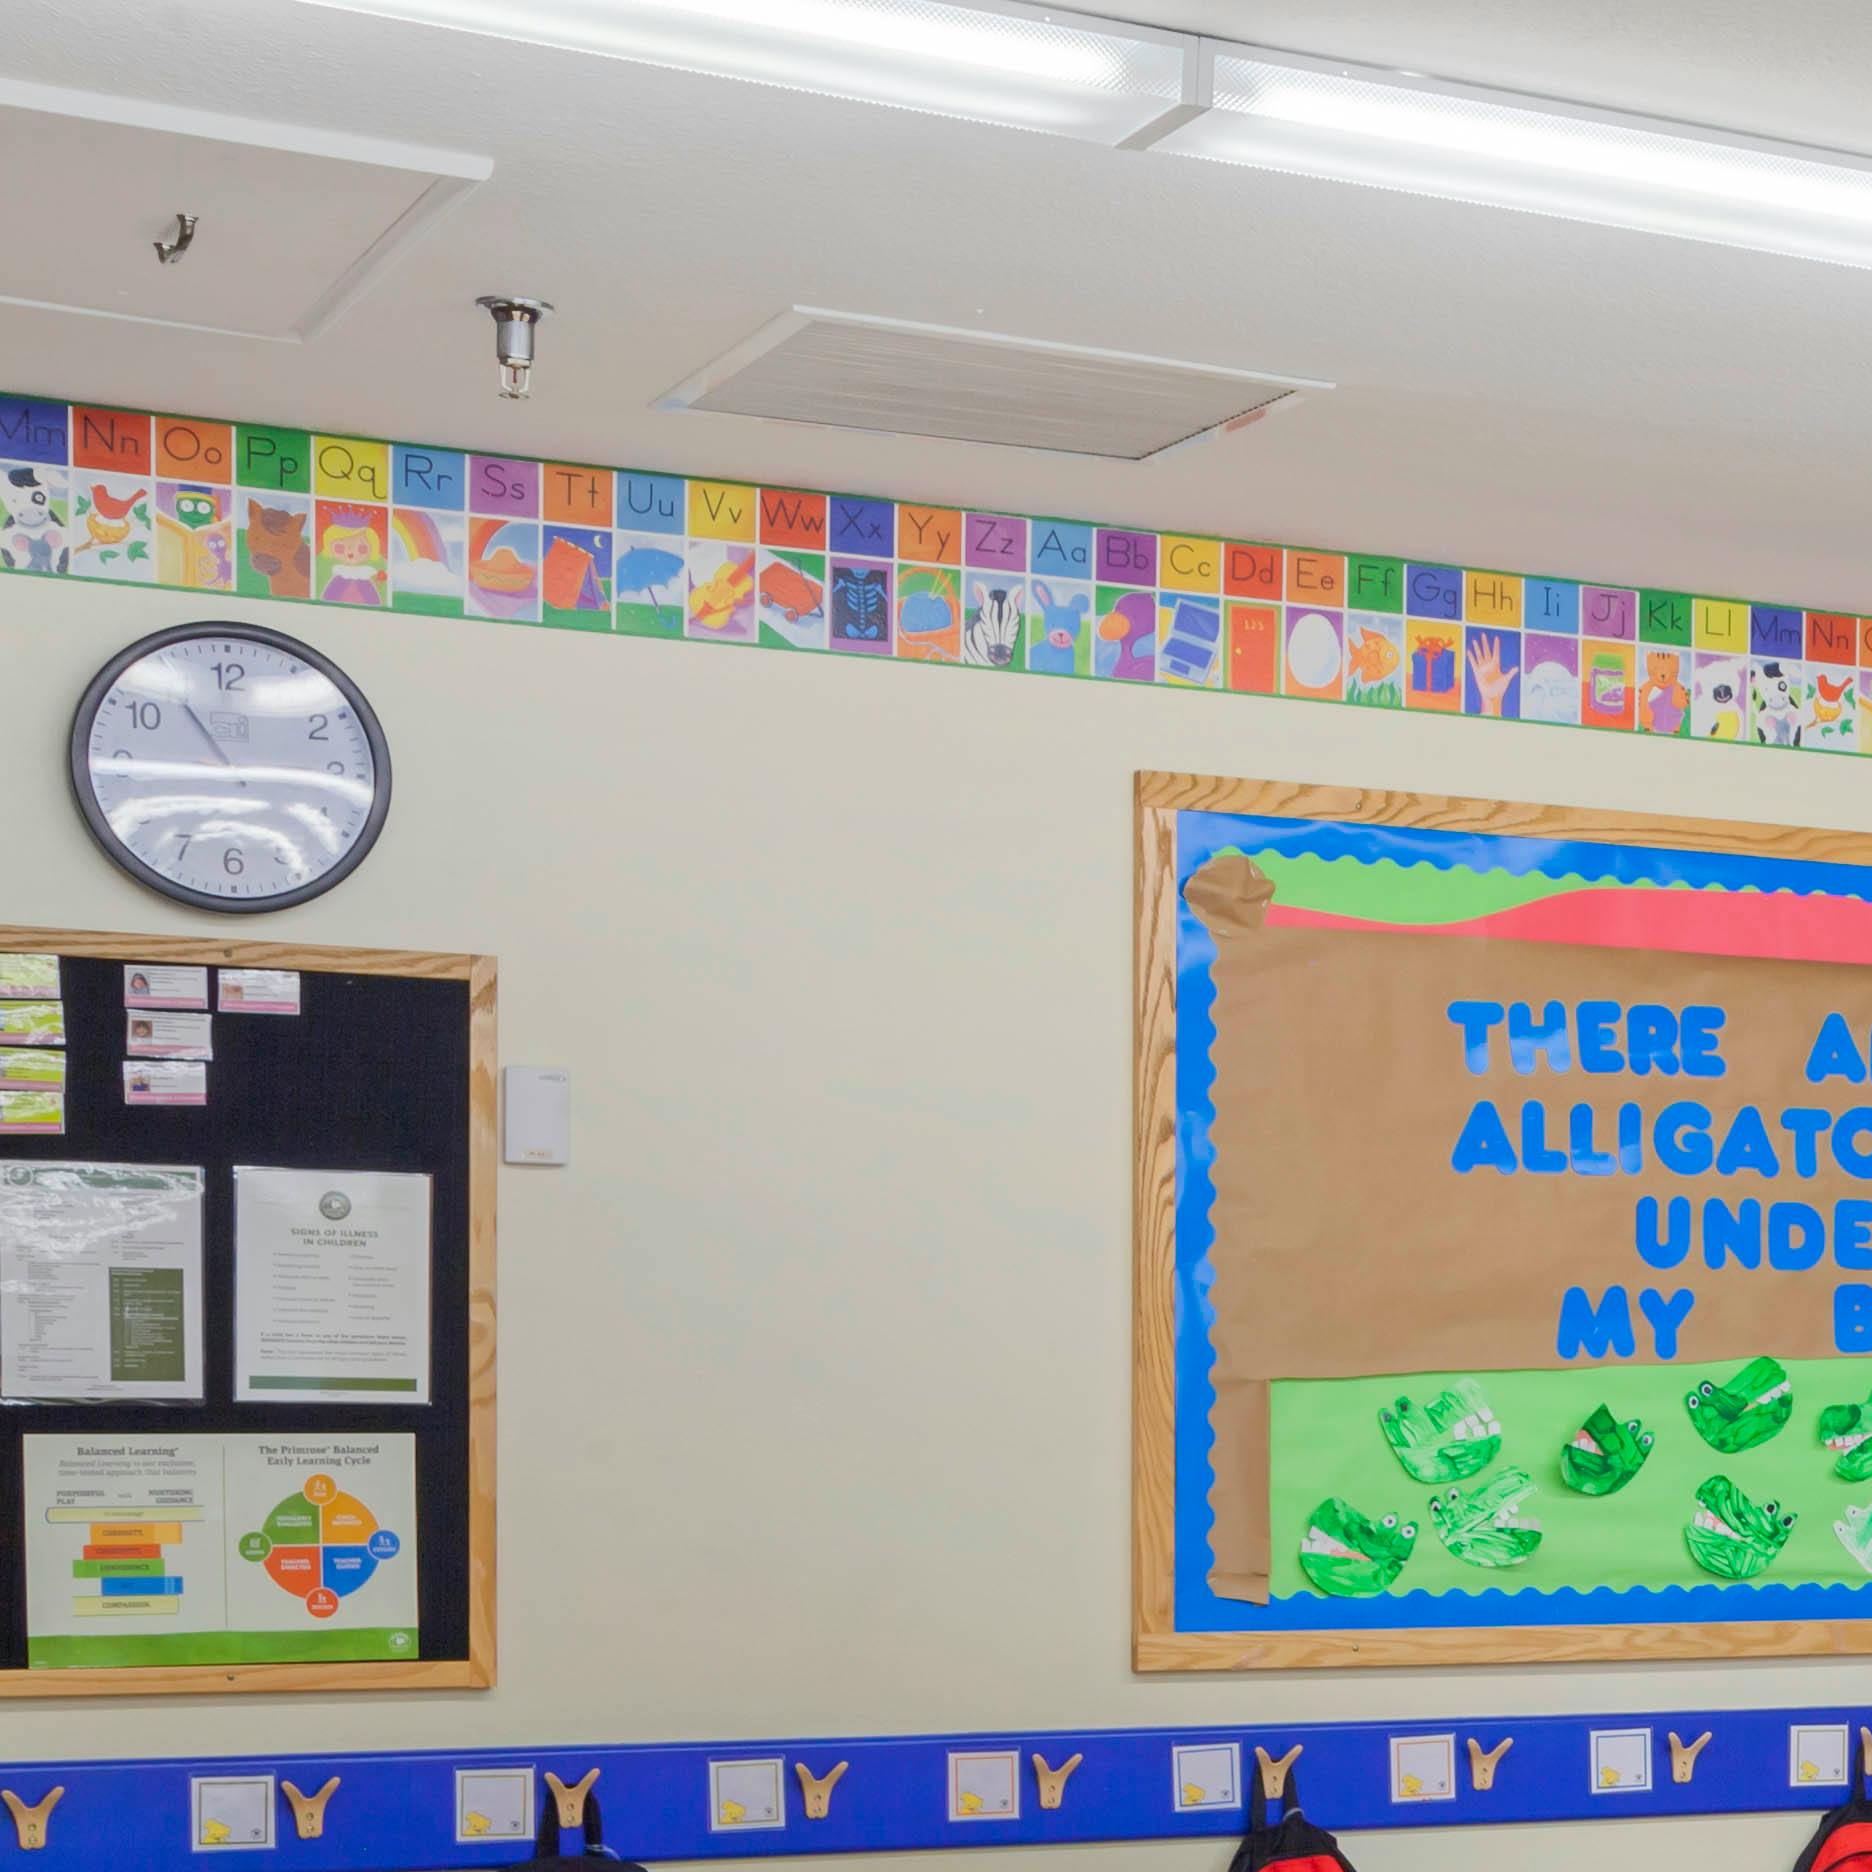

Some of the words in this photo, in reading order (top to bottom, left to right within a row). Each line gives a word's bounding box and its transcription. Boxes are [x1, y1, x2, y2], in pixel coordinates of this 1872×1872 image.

[82, 415, 142, 462] Nn
[164, 426, 222, 464] Oo
[318, 445, 387, 499] Qq
[404, 454, 452, 491] Rr
[628, 480, 674, 517] Uu
[975, 520, 1014, 554] Zz
[1037, 529, 1086, 564] Aa
[1170, 544, 1210, 577] Cc
[1474, 579, 1512, 610] Hh
[211, 663, 244, 690] 12
[126, 701, 160, 730] 10
[308, 715, 328, 740] 2
[224, 848, 244, 875] 6
[1446, 999, 1726, 1076] THERE
[1556, 1285, 1695, 1360] MY
[77, 1446, 125, 1456] Balanced
[258, 1445, 277, 1455] The
[333, 1445, 379, 1455] Balanced
[267, 1455, 293, 1466] Early
[297, 1455, 341, 1466] Learning
[345, 1455, 370, 1466] Cycle
